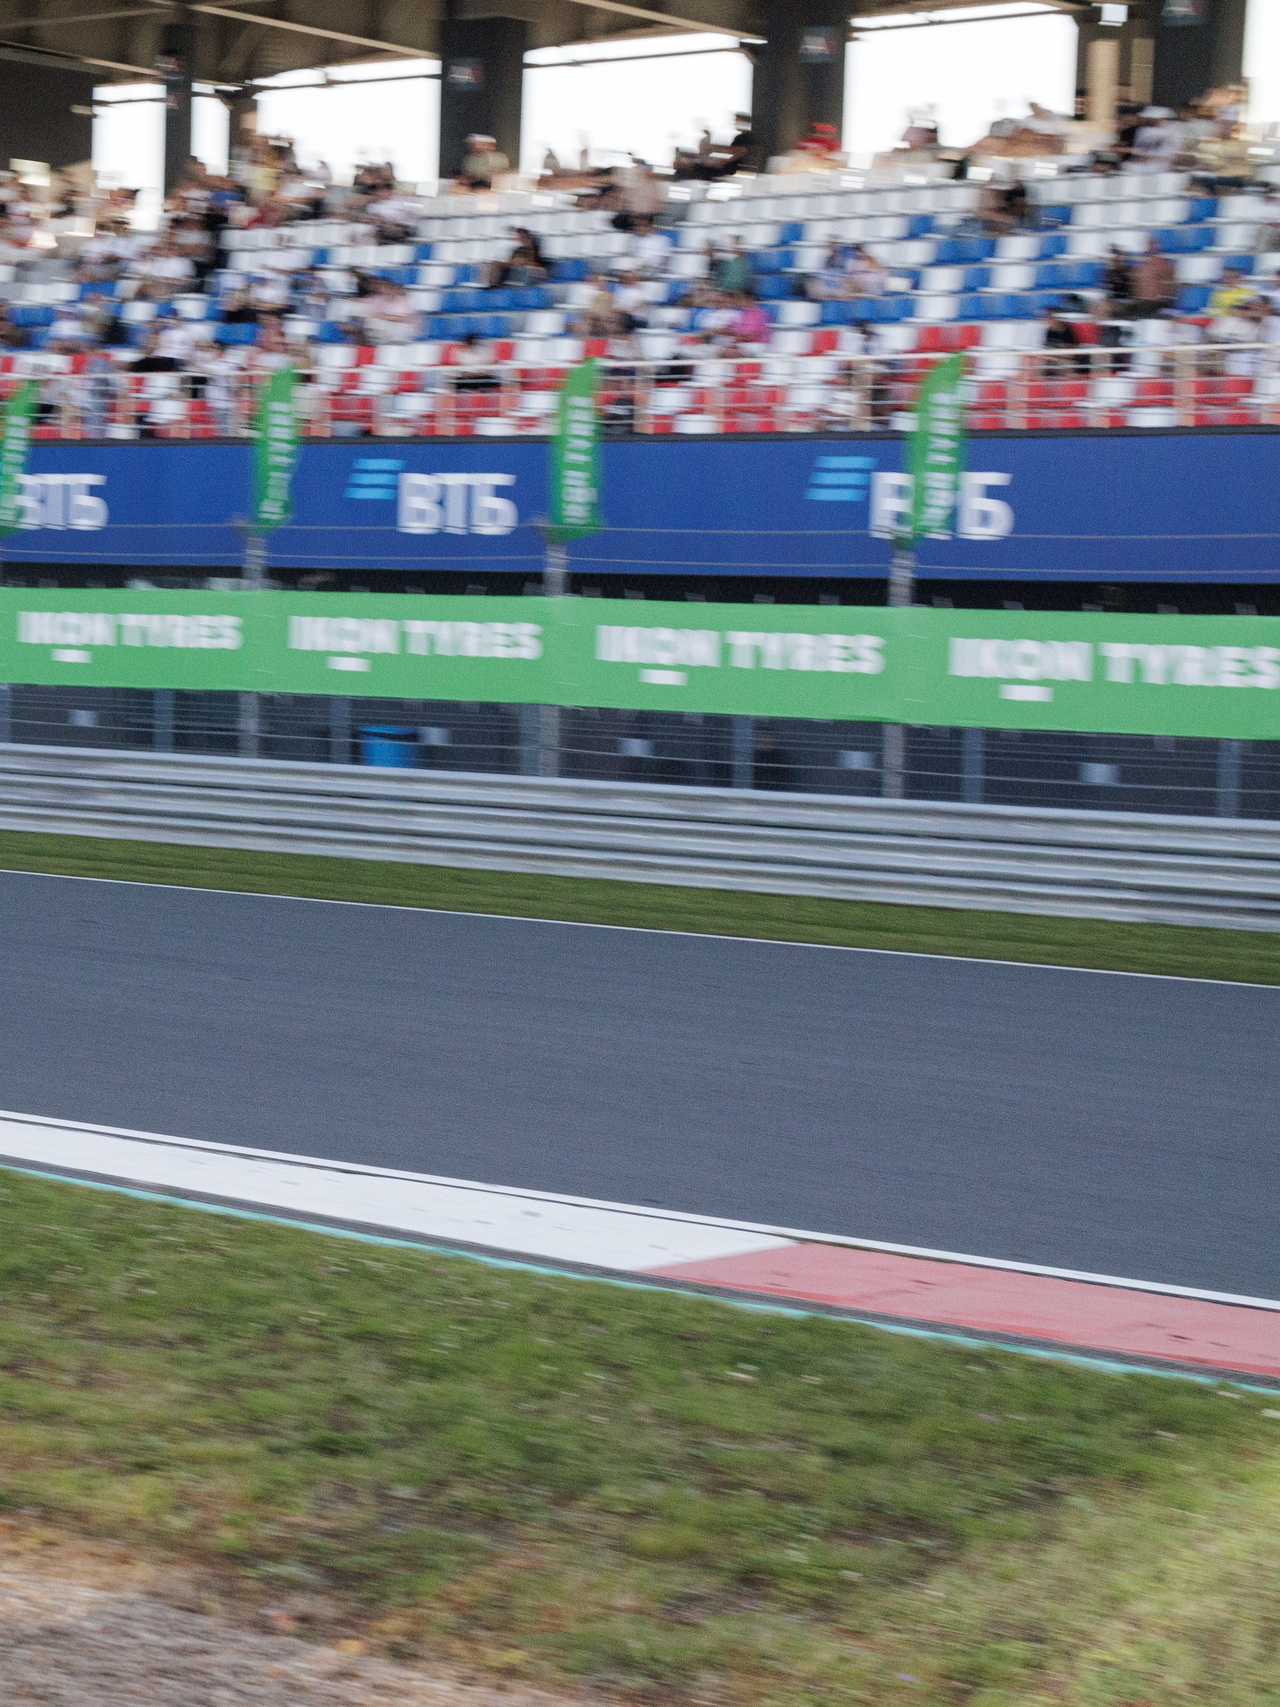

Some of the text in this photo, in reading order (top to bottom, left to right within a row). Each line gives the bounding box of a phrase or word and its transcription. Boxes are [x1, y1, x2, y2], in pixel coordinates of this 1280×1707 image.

[397, 472, 519, 536] ВТБ
[869, 471, 1015, 541] ВБ
[594, 625, 887, 676] IKON TYRES
[947, 637, 1280, 690] IKON TYRES
